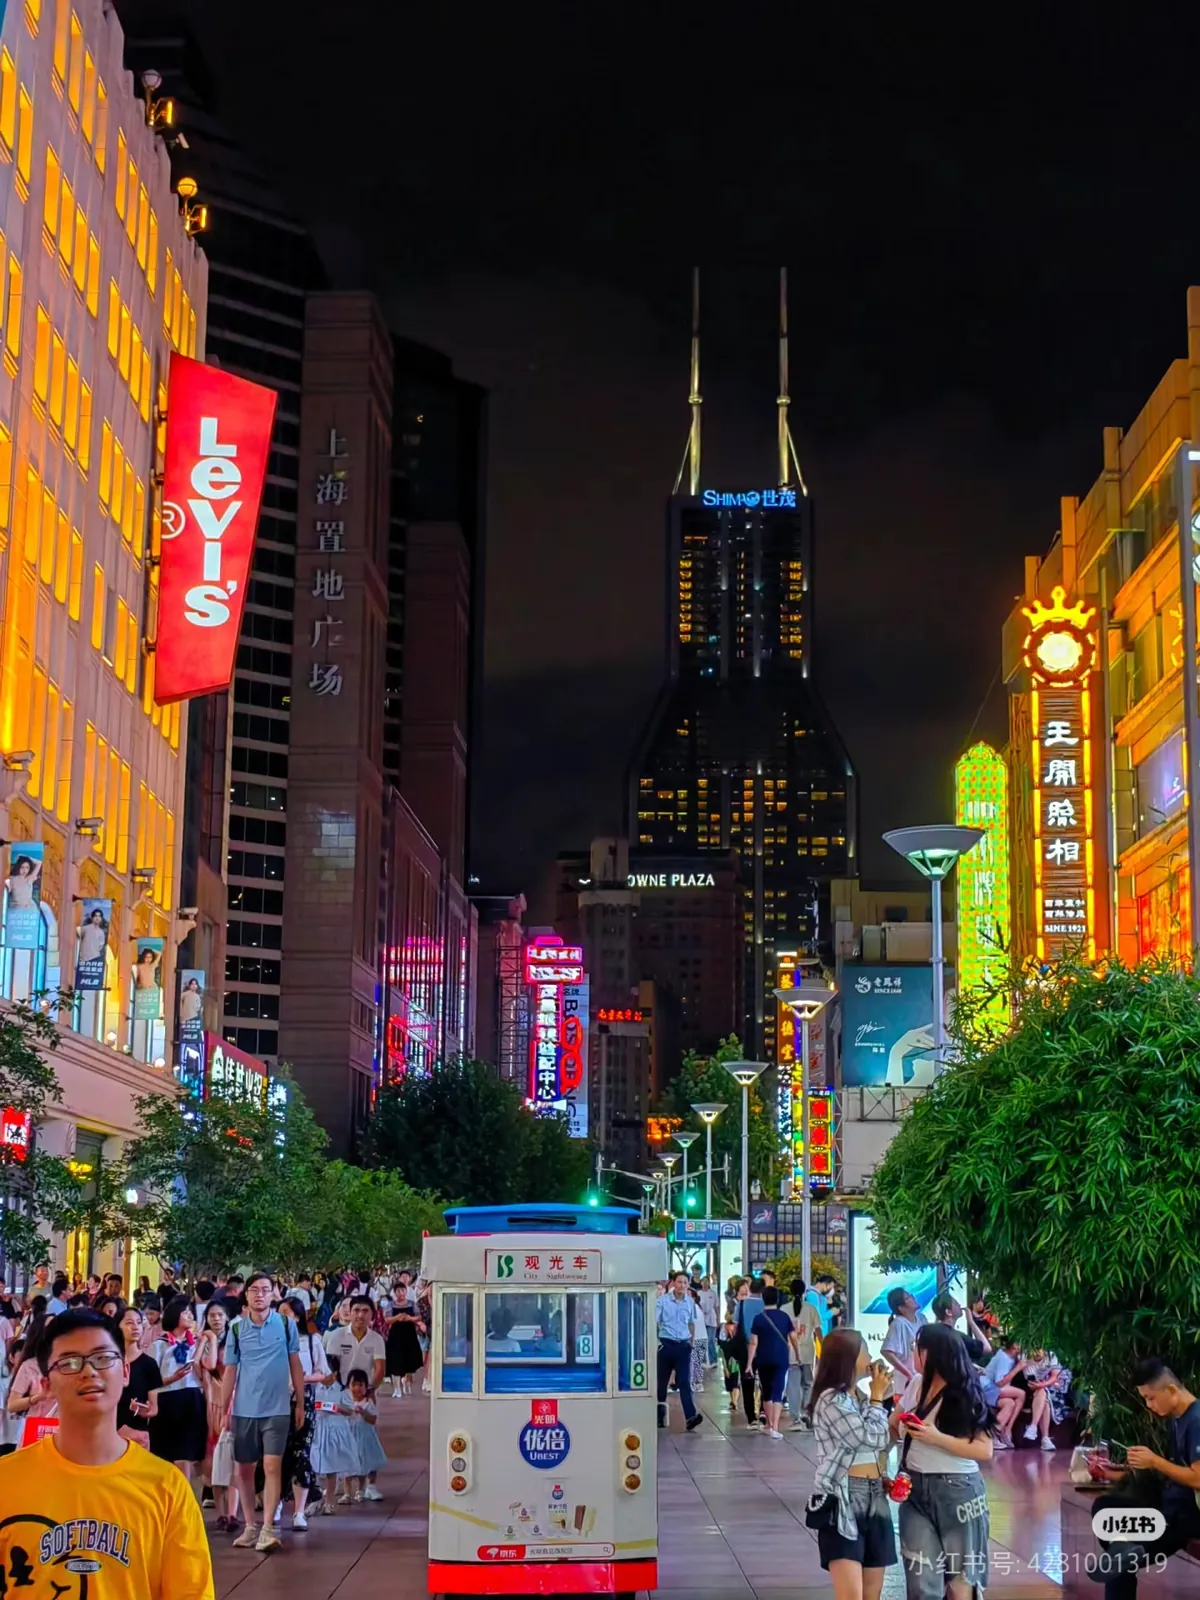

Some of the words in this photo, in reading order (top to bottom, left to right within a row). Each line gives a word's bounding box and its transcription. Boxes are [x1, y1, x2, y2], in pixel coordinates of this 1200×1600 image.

[762, 489, 796, 507] 世茂
[308, 428, 349, 697] 上海置地广场
[671, 873, 715, 887] PLAZA
[80, 978, 100, 986] MLB
[524, 1255, 589, 1270] 观光车
[523, 1272, 538, 1280] City
[582, 1336, 591, 1355] 8
[632, 1362, 645, 1387] 8
[534, 1414, 556, 1425] 光明
[523, 1428, 566, 1451] 优倍
[39, 1518, 131, 1568] SOFTBALL
